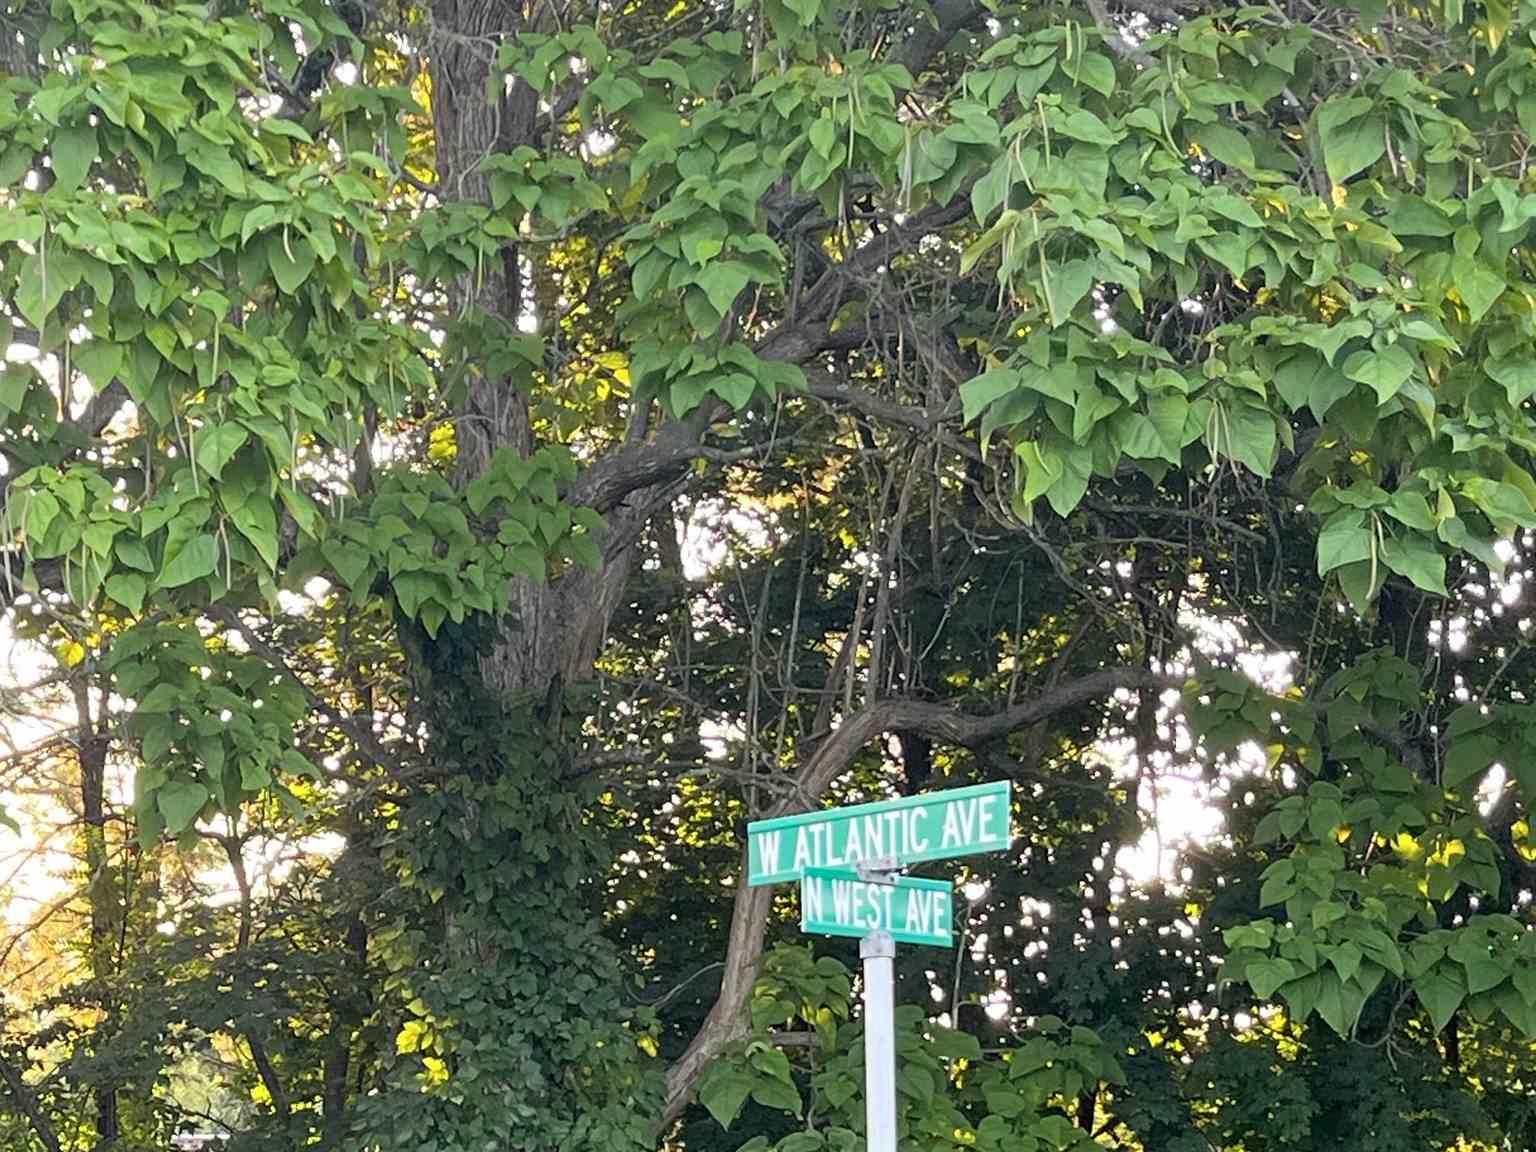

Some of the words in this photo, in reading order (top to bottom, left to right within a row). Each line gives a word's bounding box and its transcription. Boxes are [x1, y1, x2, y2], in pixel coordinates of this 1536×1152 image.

[758, 832, 782, 875] W
[793, 807, 928, 869] ATLANTIC
[941, 796, 997, 849] AVE
[806, 877, 822, 922] N
[832, 880, 894, 930] WEST
[905, 888, 949, 935] AVE
